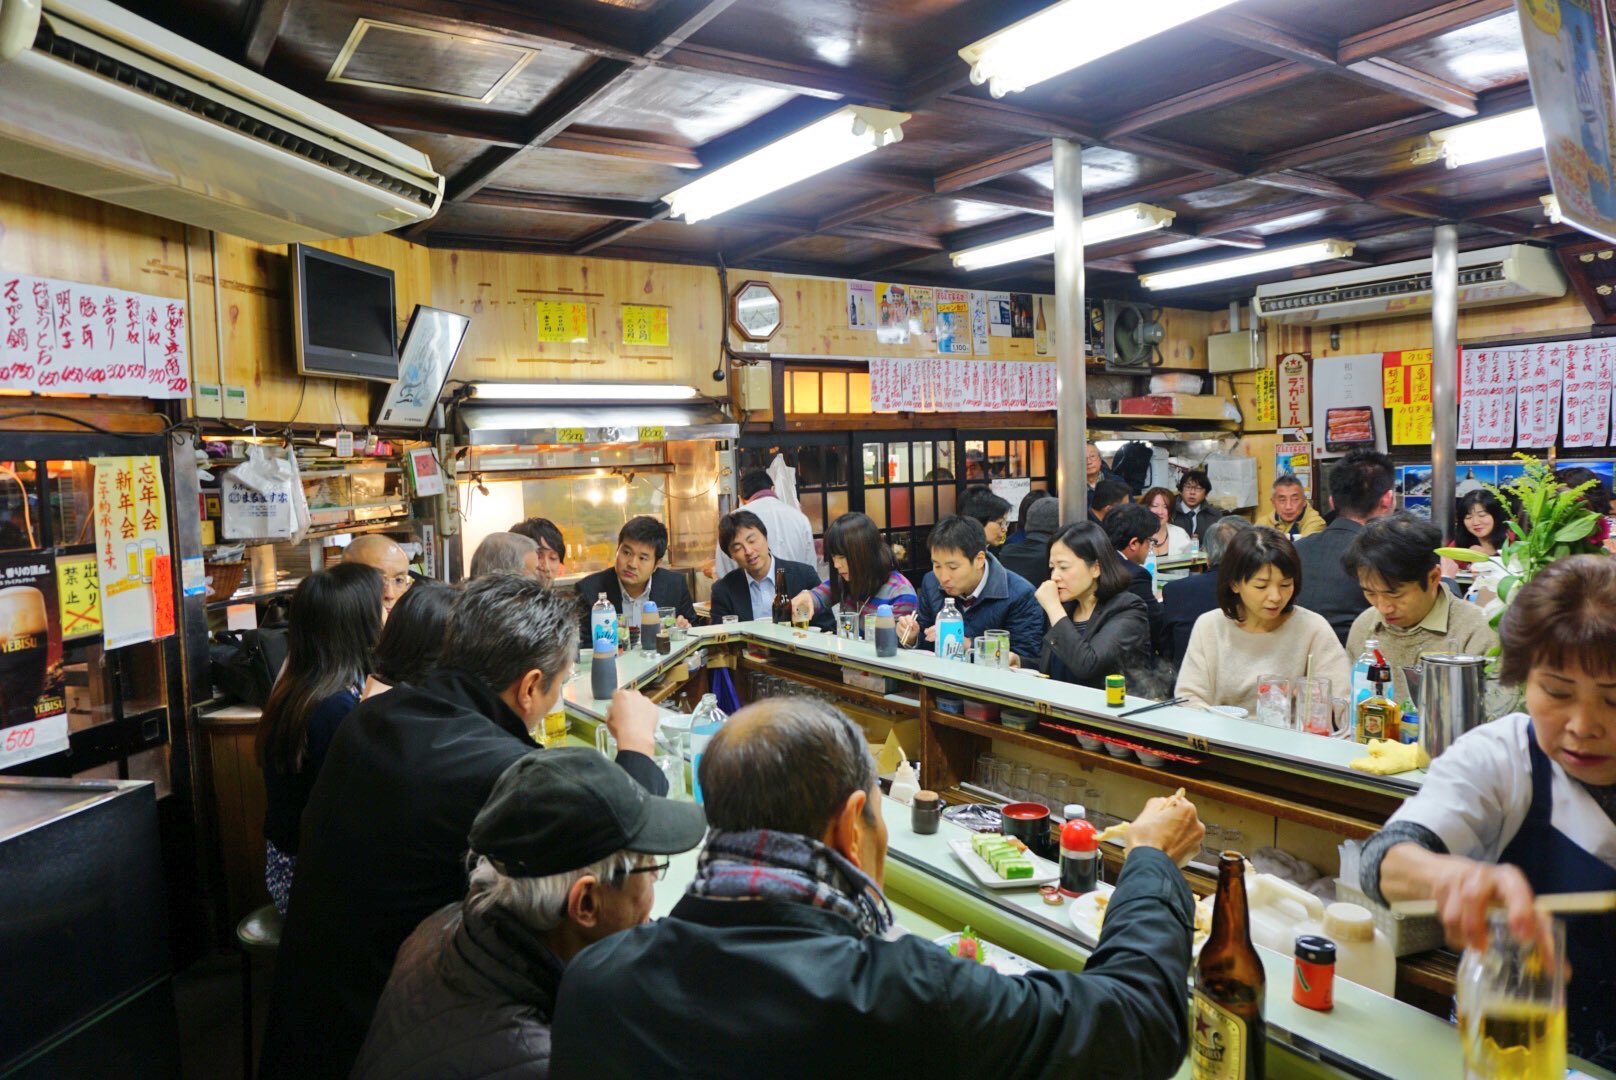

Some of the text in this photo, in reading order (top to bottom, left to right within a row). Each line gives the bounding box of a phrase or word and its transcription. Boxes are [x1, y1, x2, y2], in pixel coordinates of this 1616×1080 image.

[56, 288, 75, 349] 明太子
[102, 294, 118, 351] 岩のり
[116, 468, 135, 539] 新年会
[138, 462, 159, 531] 忘年会
[98, 473, 118, 571] ご予約承ります。
[64, 567, 80, 605] 禁止
[84, 563, 100, 605] 出入り
[1, 637, 37, 653] YEBISU
[717, 634, 727, 642] 10
[34, 699, 65, 714] YEBISU
[5, 726, 35, 751] 500
